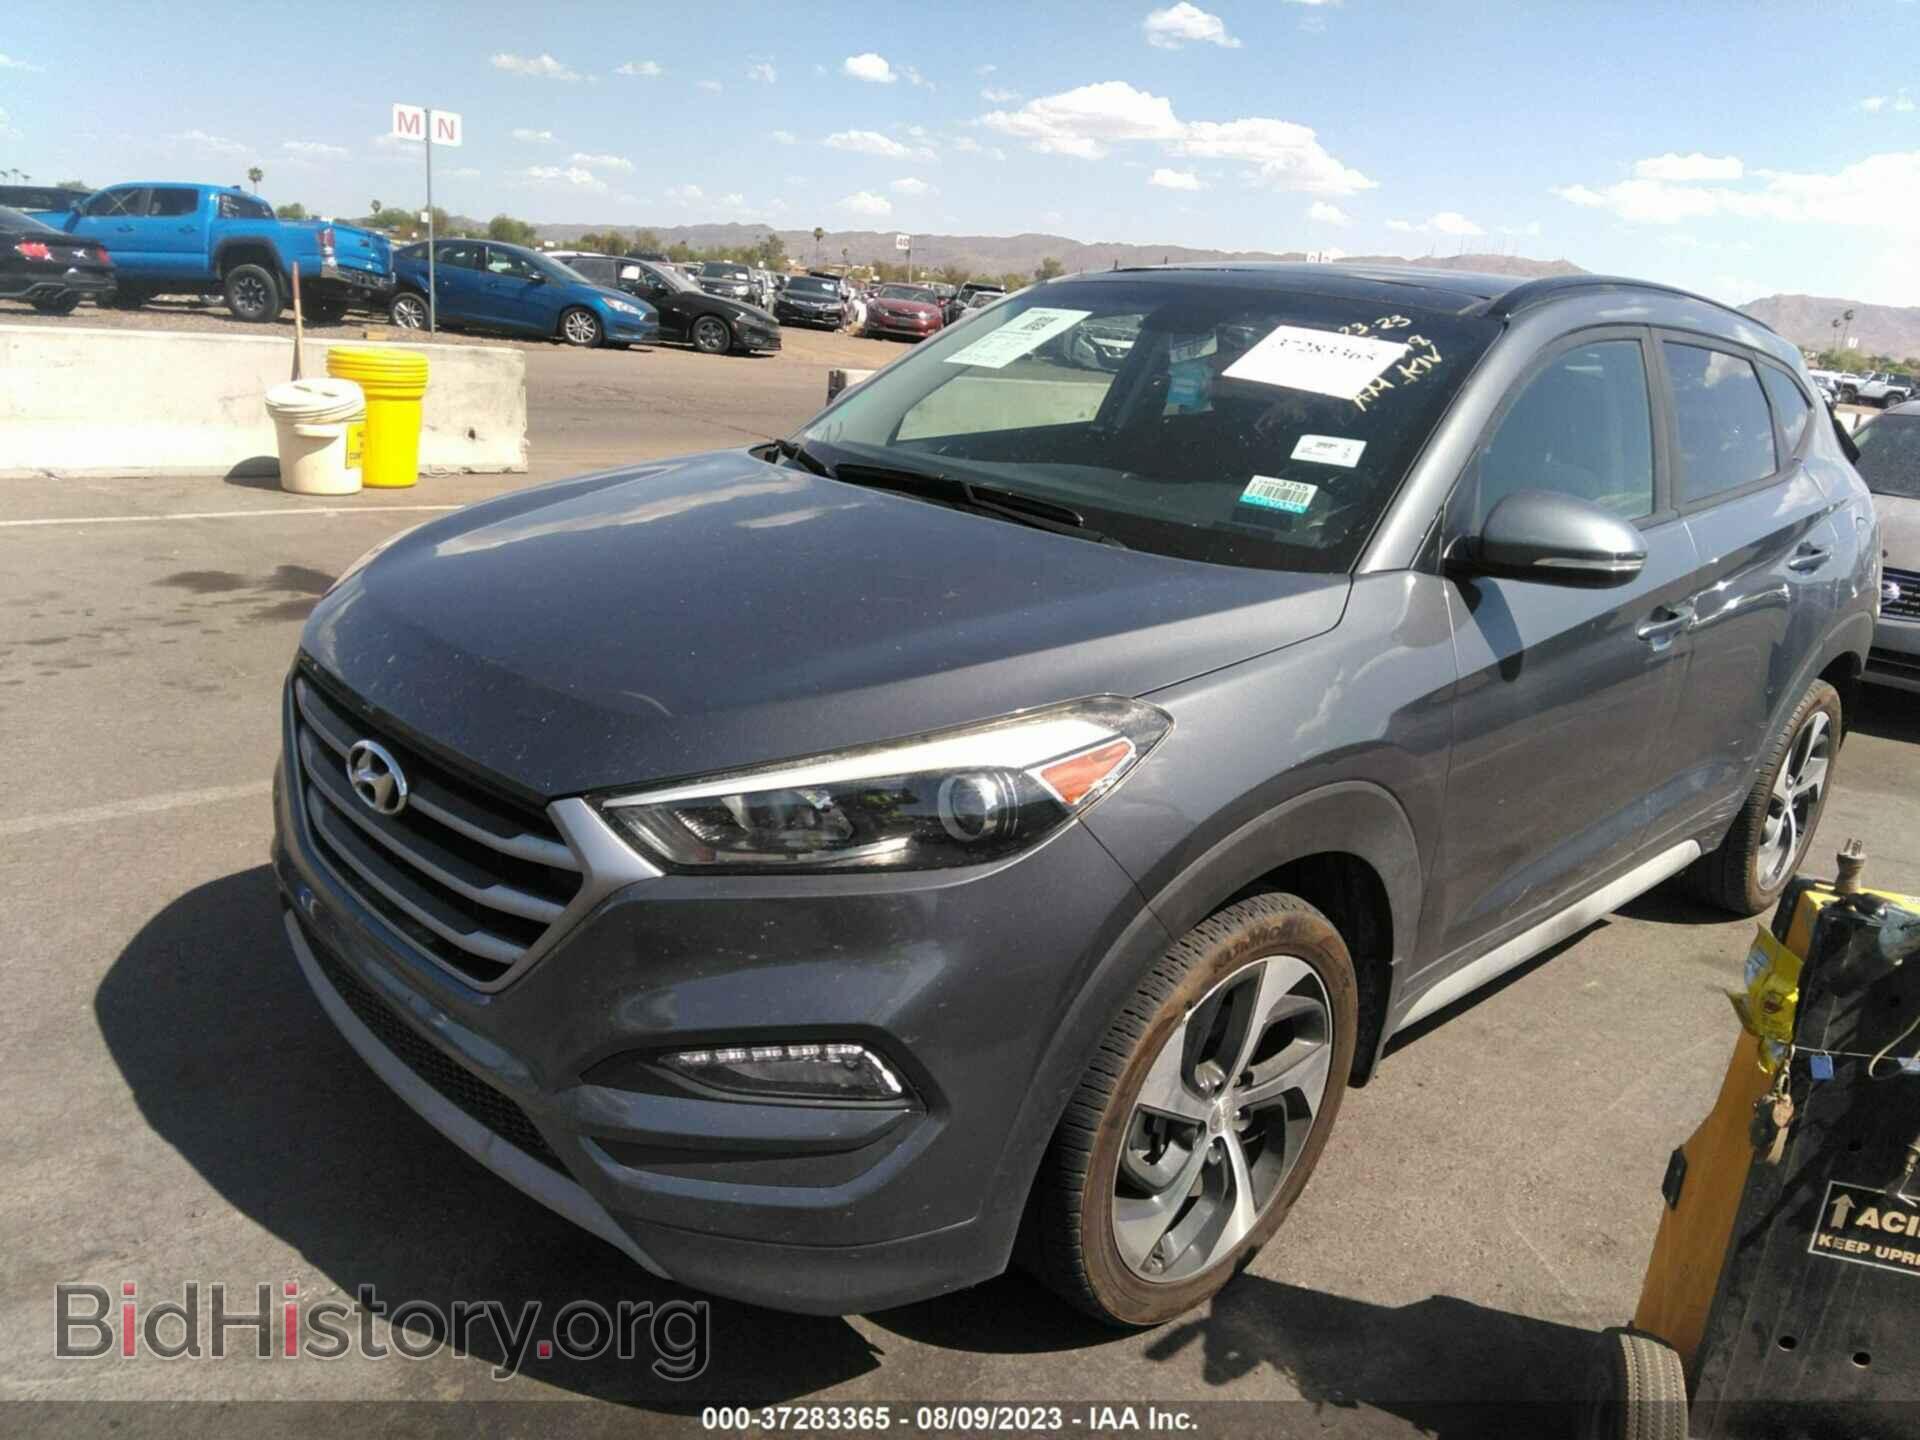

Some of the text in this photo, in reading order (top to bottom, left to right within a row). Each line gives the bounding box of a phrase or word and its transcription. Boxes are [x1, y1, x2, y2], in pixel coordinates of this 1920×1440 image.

[397, 111, 420, 135] M
[438, 117, 455, 140] N
[1855, 1207, 1920, 1238] ACI
[1817, 1233, 1871, 1254] KEEP
